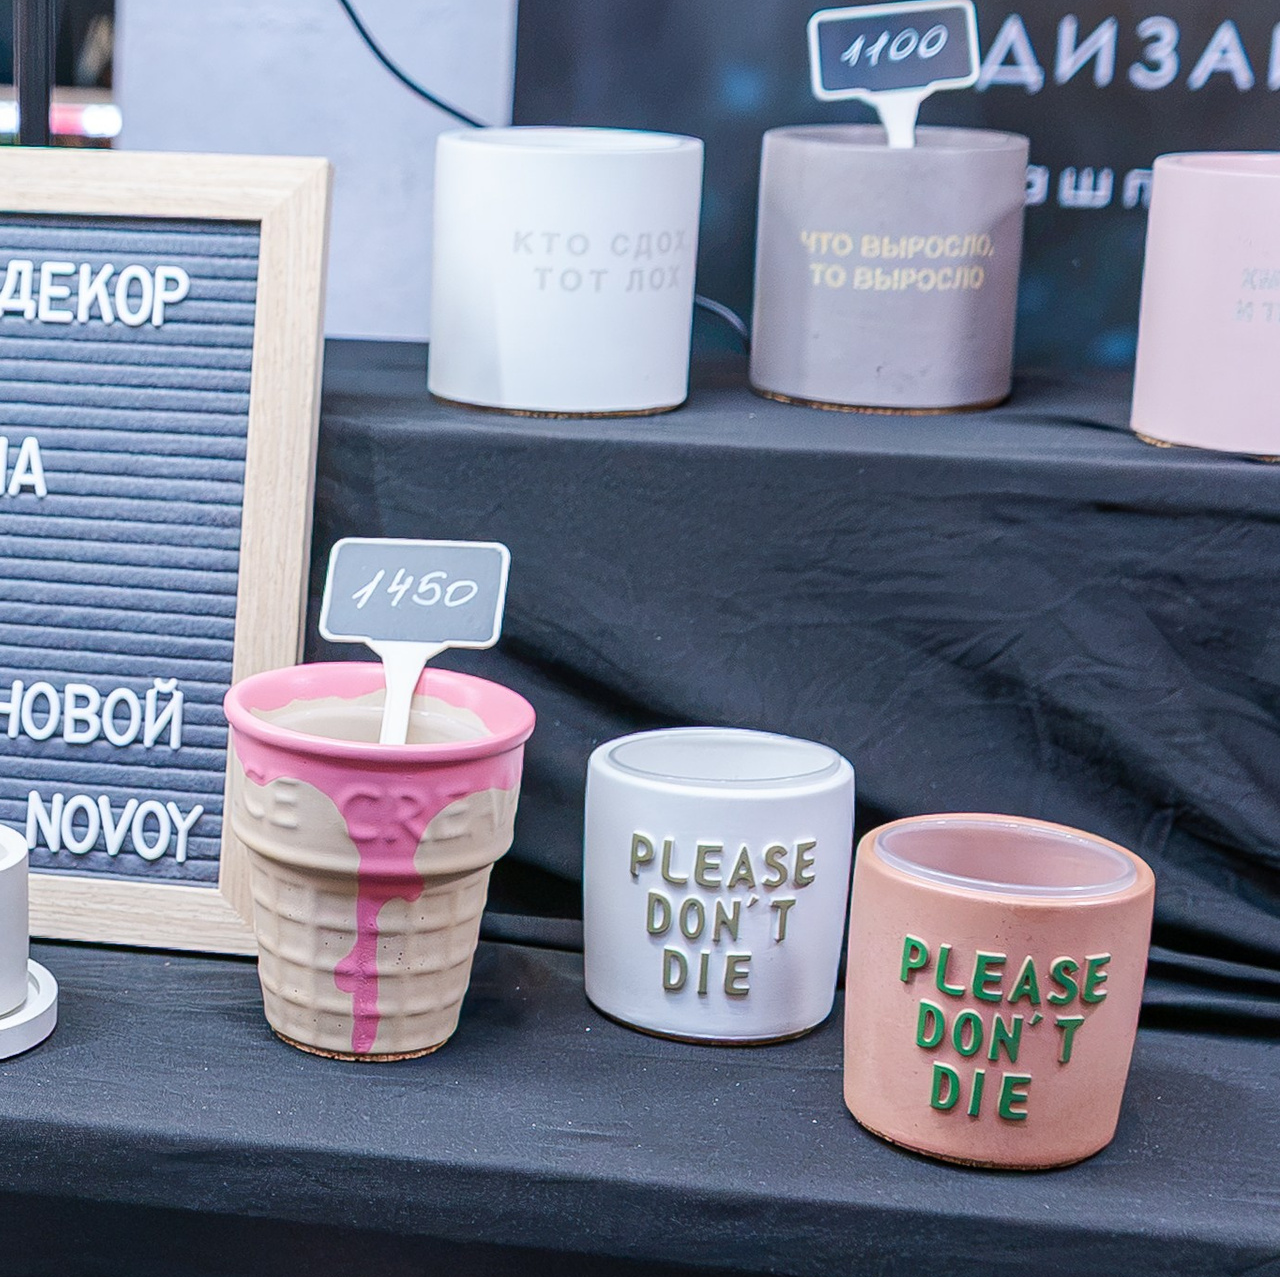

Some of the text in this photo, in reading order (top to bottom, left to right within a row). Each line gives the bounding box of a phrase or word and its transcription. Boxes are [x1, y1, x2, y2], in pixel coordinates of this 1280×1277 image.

[839, 23, 949, 68] 1100
[976, 12, 1280, 94] ДИЗА
[512, 230, 590, 257] КТО
[799, 230, 854, 257] ЧТО
[533, 264, 681, 293] ТОТ ЛОХ
[809, 262, 986, 292] ТО ВЫРОСЛО
[352, 567, 479, 610] 1450
[26, 789, 206, 864] NOVOY
[629, 829, 818, 891] PLEASE
[662, 944, 753, 996] DIE
[899, 933, 1113, 1006] PLEASE
[929, 1060, 1033, 1122] DIE
